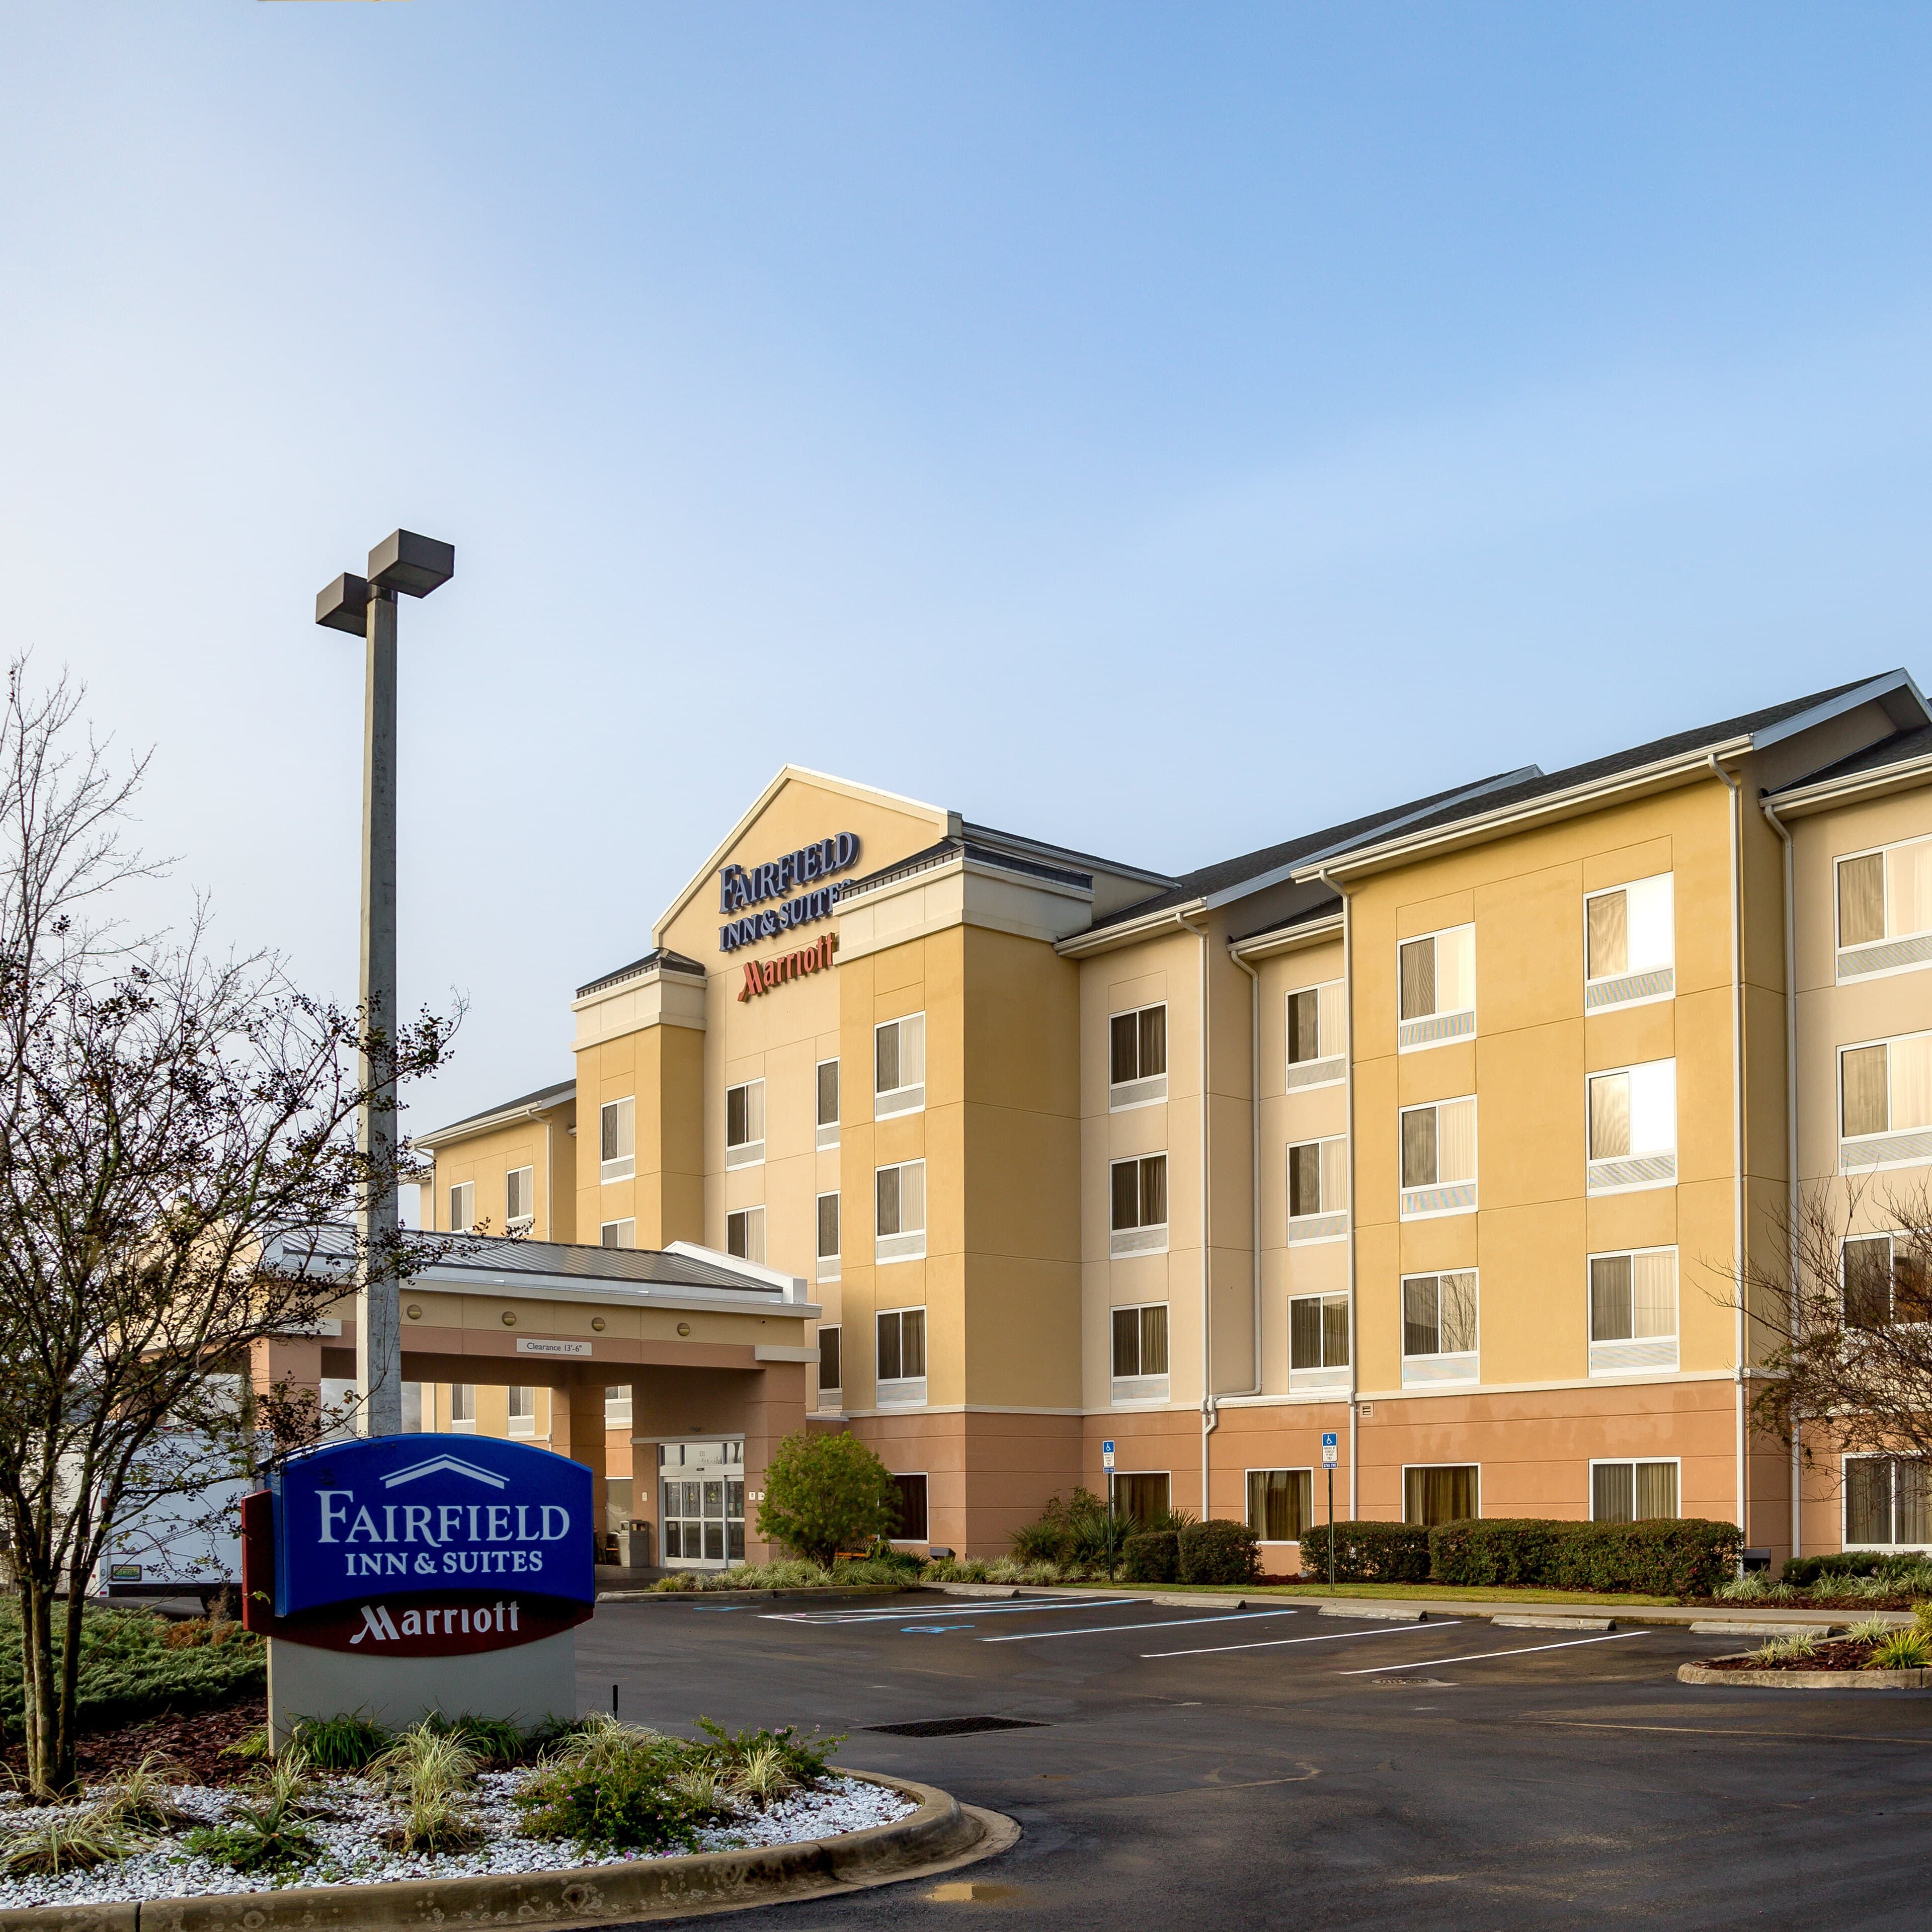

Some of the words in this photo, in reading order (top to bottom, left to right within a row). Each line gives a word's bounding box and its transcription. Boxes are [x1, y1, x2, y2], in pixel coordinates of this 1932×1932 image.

[719, 832, 859, 914] FAIRFIELD
[719, 914, 763, 952] INN
[760, 910, 777, 936] &
[738, 932, 839, 1002] Marriott
[527, 1342, 561, 1351] Clearance
[314, 1490, 570, 1547] FAIRFIELD
[345, 1553, 408, 1576] INN
[414, 1552, 438, 1574] &
[443, 1551, 543, 1574] SUITES
[349, 1600, 520, 1644] Marriott
